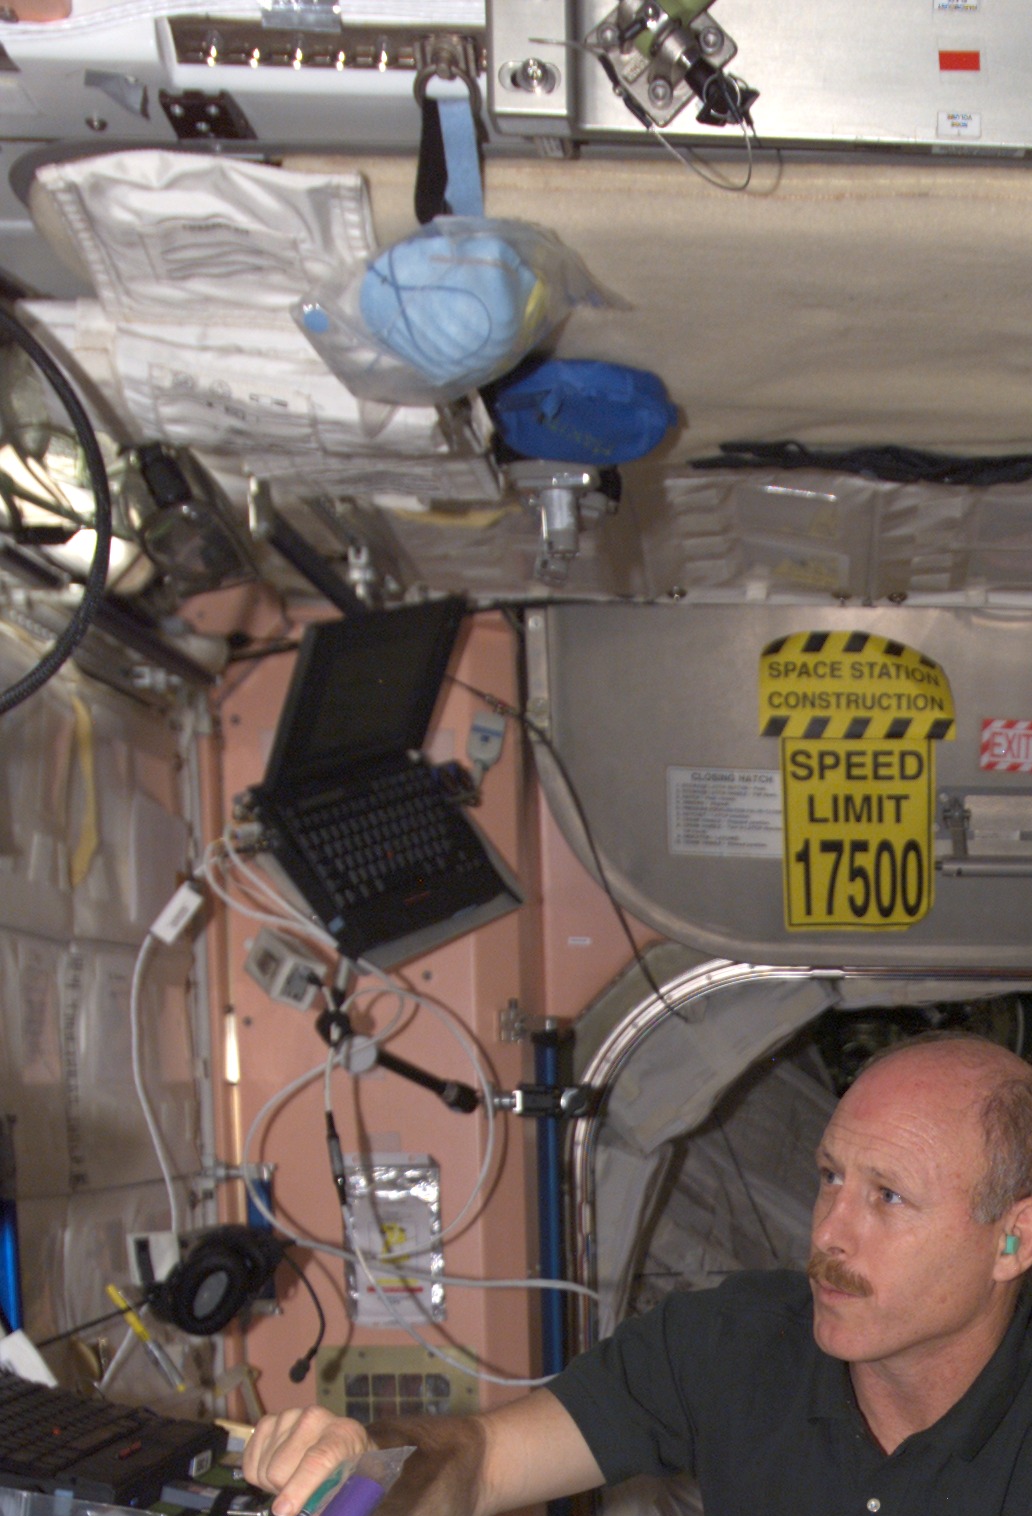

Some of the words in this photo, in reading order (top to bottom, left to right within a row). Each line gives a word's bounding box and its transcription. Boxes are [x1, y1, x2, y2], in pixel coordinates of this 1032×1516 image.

[767, 661, 842, 680] SPACE
[850, 661, 940, 687] STATION
[767, 691, 944, 711] CONSTRUCTION
[790, 749, 924, 781] SPEED
[808, 794, 910, 824] LIMIT
[796, 838, 924, 918] 17500
